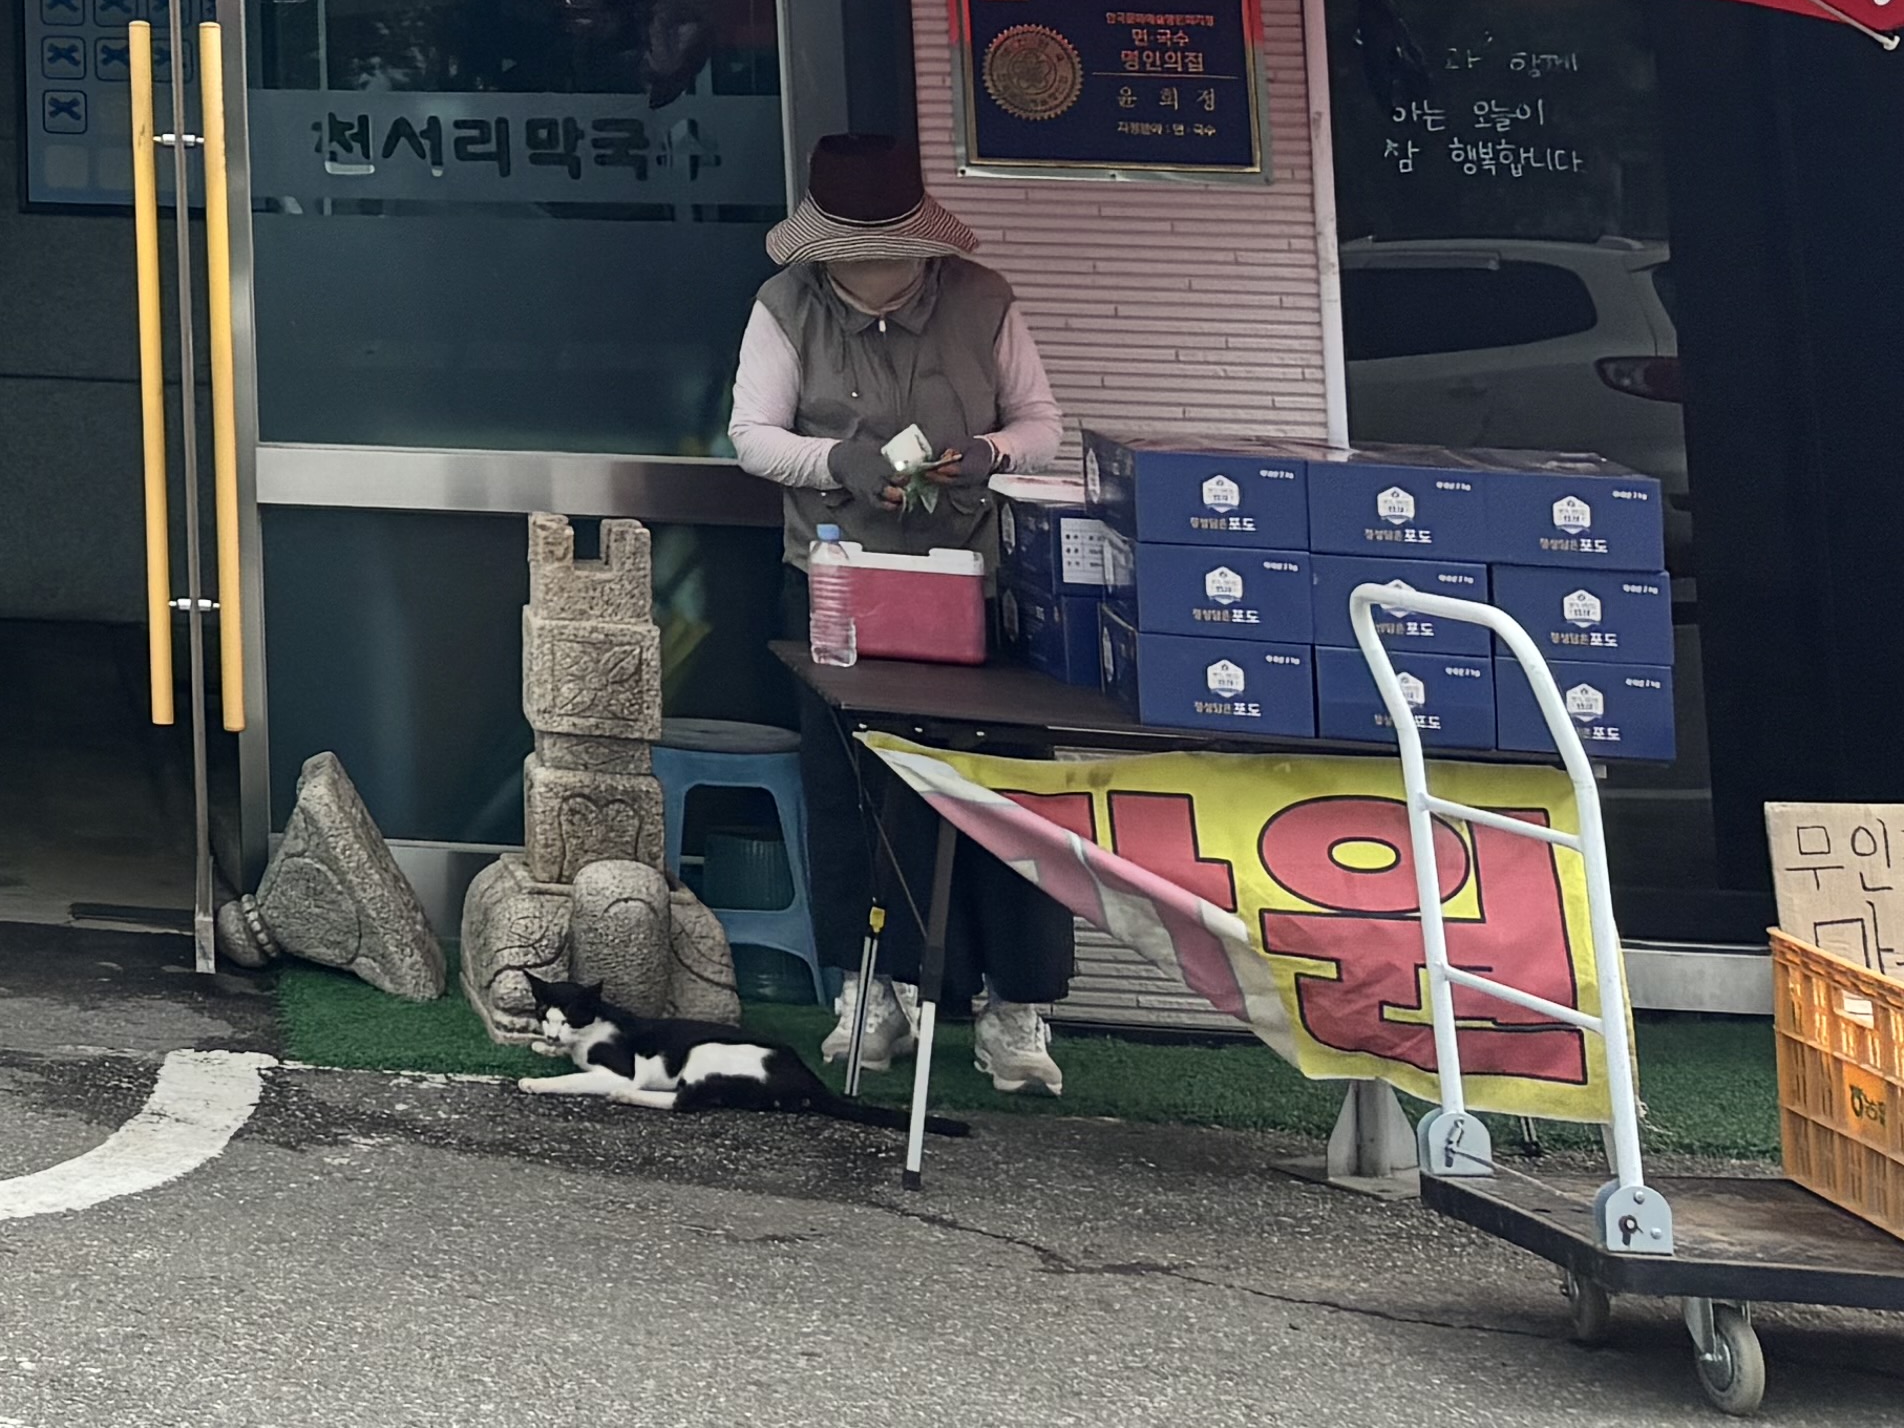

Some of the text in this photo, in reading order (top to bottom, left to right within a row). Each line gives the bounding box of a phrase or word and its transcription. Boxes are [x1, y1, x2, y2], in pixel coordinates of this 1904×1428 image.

[1121, 49, 1204, 72] 명인의집
[1472, 98, 1544, 132] 오늘이
[1383, 138, 1420, 173] 참
[1785, 818, 1904, 891] 무인
